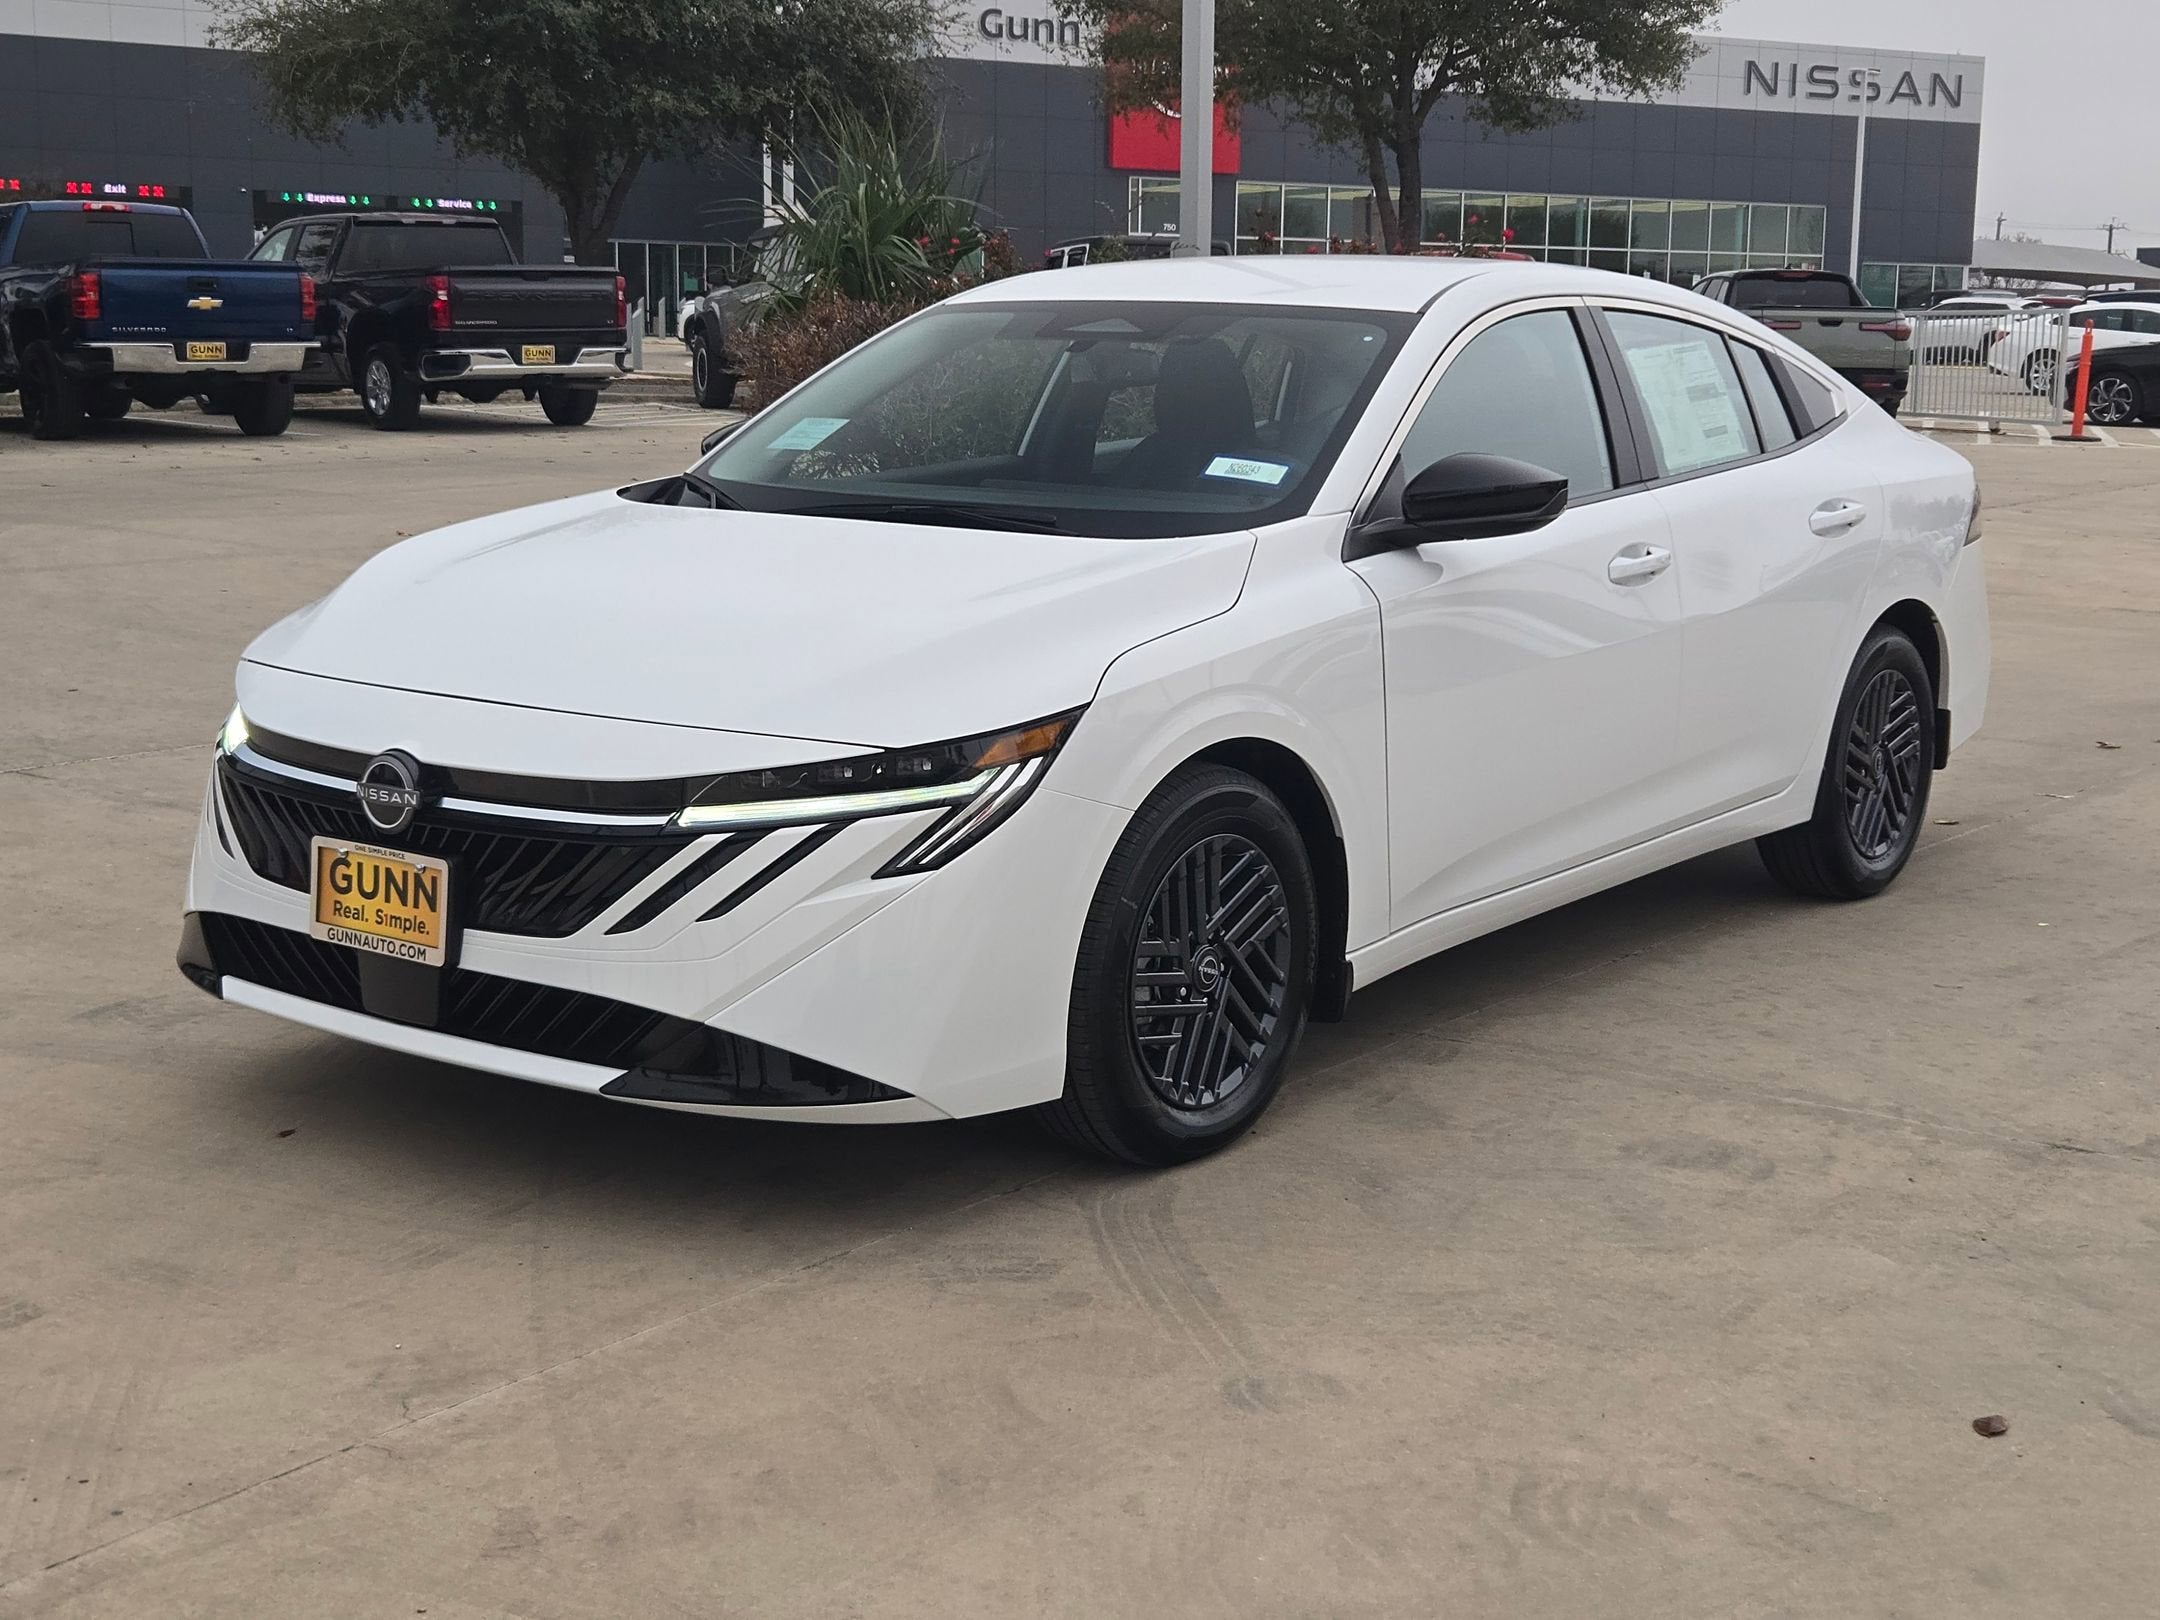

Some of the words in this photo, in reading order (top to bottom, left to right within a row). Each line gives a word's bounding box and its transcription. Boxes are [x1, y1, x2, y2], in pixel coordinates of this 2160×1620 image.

[979, 8, 1080, 48] Gunn
[1744, 59, 1963, 108] NISSAN
[103, 183, 127, 194] Exit
[305, 193, 347, 204] Express
[436, 199, 473, 210] Service
[1163, 223, 1177, 232] 750
[190, 344, 223, 355] GUNN
[525, 349, 552, 358] GUNN
[357, 784, 417, 805] NISSAN
[367, 847, 388, 857] SIMPLE
[388, 851, 406, 860] PRICE
[329, 857, 438, 913] GUNN
[333, 900, 369, 923] Real.
[327, 927, 427, 961] GUNNAUTO.COM
